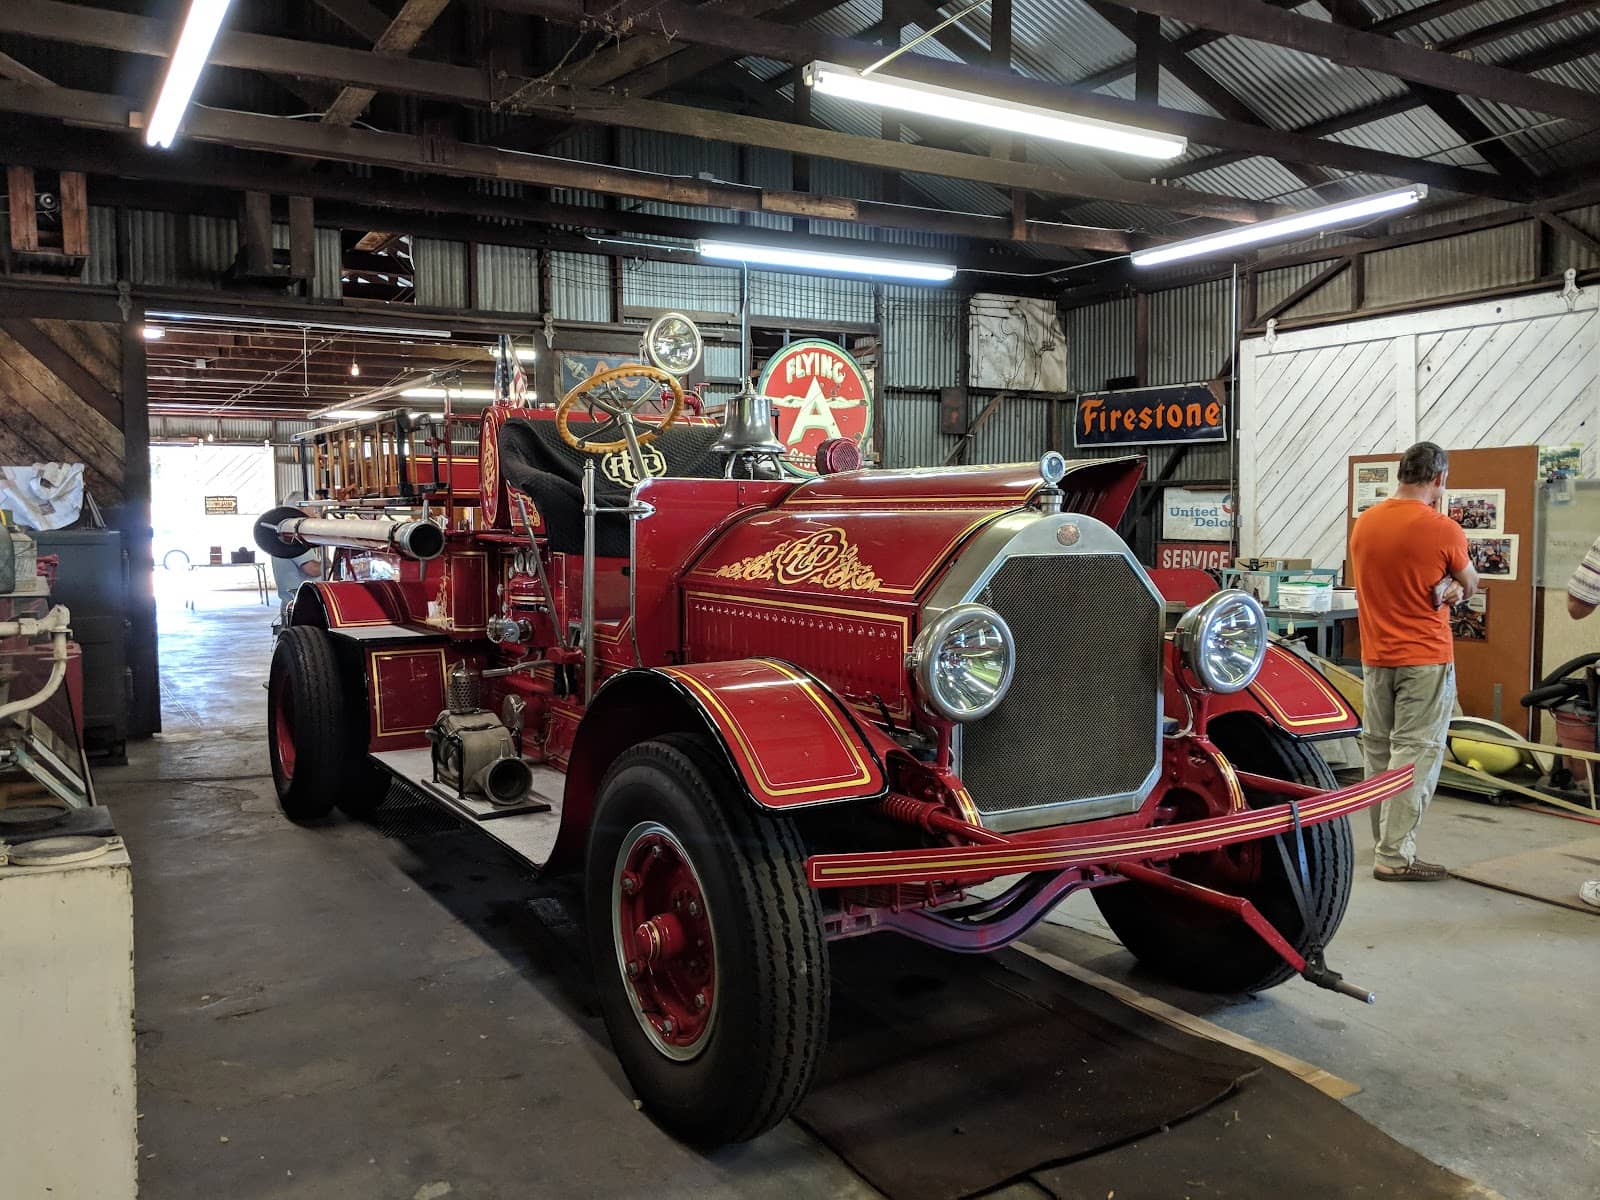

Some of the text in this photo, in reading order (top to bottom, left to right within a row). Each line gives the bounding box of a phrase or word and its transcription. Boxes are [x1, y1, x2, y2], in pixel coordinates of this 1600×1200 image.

[786, 352, 846, 384] FLYING
[1080, 399, 1220, 436] Firestone
[1169, 507, 1219, 517] United
[1163, 549, 1230, 570] SERVICE
